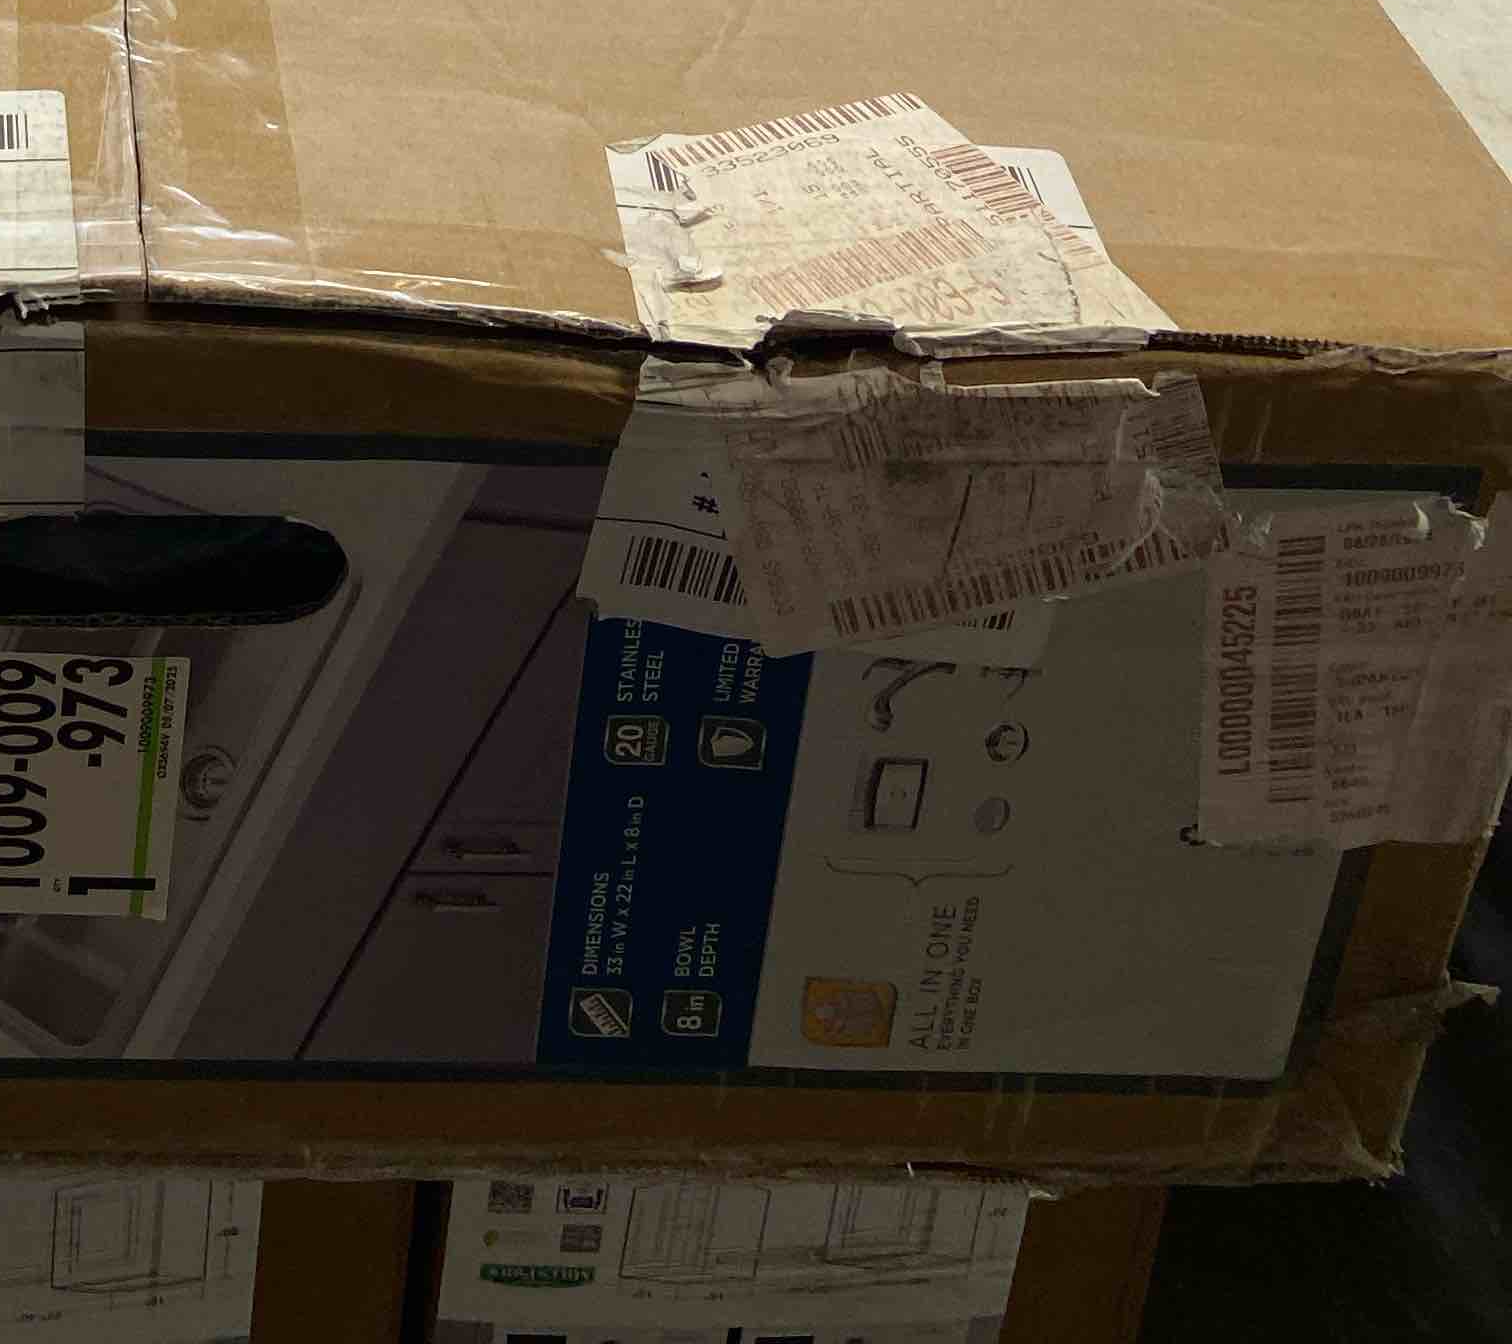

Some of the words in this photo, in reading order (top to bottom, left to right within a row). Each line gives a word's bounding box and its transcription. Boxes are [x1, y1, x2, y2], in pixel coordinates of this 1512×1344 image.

[641, 649, 665, 703] STEEL
[713, 638, 740, 703] LIMITED
[57, 658, 134, 768] -973
[615, 724, 644, 758] 20
[627, 795, 645, 809] D
[623, 826, 641, 838] 8
[620, 855, 637, 866] L
[67, 877, 156, 896] 1
[615, 883, 633, 904] 22
[581, 871, 610, 977] DIMENSIONS
[610, 920, 628, 939] W
[926, 903, 957, 959] ONE
[615, 942, 625, 956] in
[674, 926, 697, 977] BOWL
[698, 922, 721, 977] DEPTH
[606, 957, 624, 977] 33
[920, 969, 943, 992] IN
[689, 995, 705, 1012] in
[676, 1015, 703, 1031] 8
[909, 1004, 937, 1049] ALL
